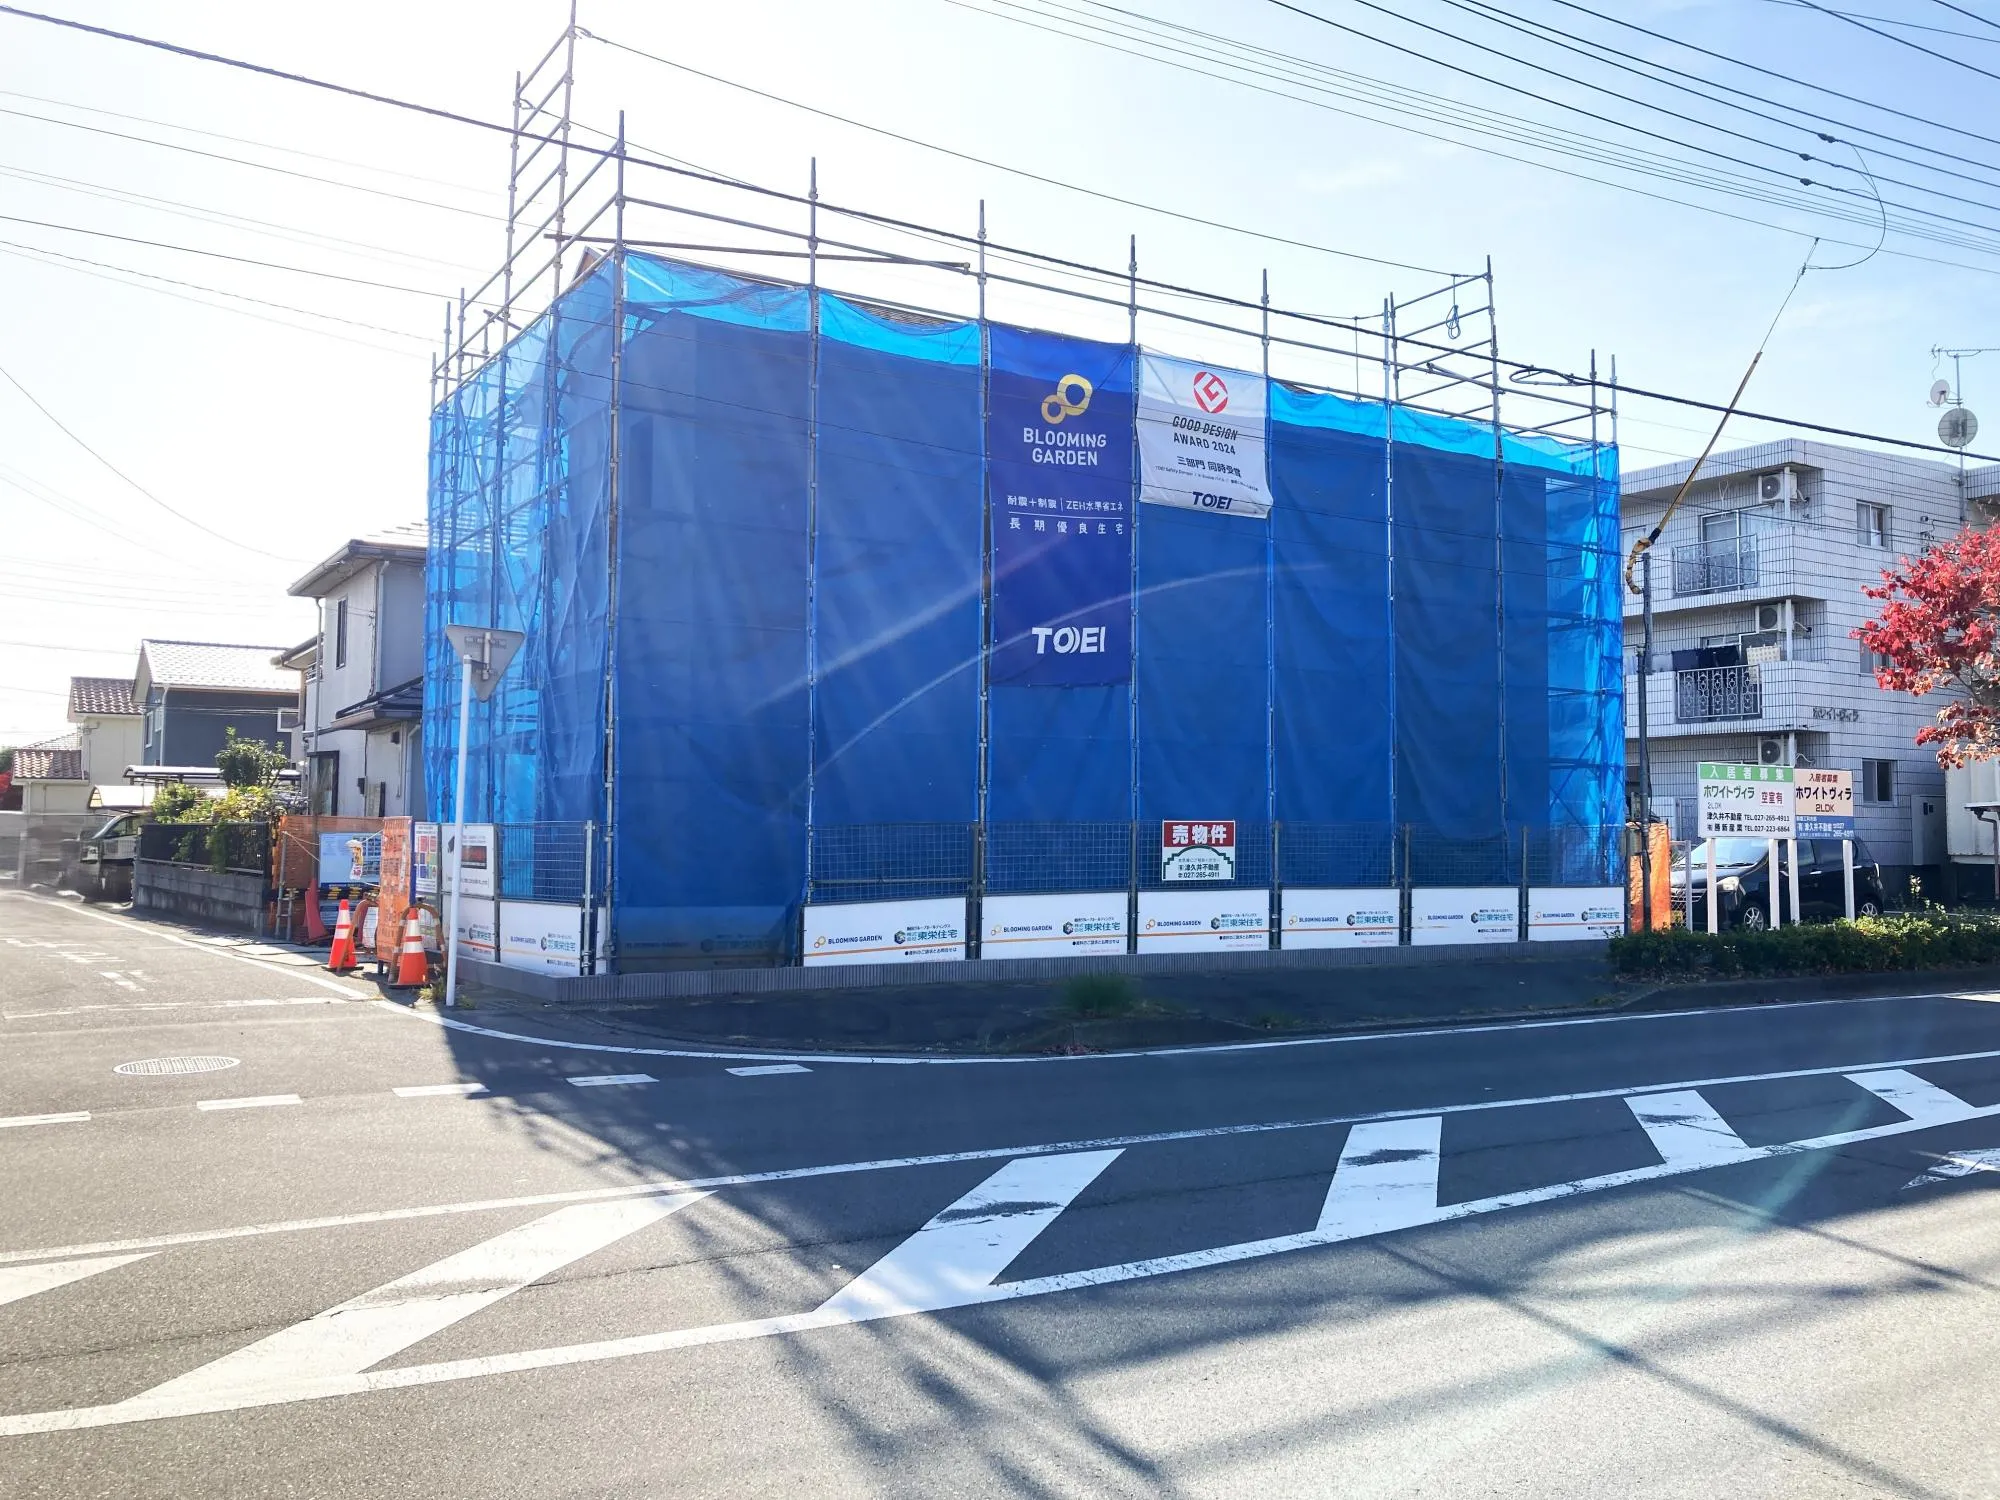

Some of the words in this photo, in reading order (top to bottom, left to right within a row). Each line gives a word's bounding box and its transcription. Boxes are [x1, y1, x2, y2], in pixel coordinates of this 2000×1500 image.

[1172, 416, 1201, 432] GOOD
[1203, 423, 1239, 440] DESIGN
[1023, 427, 1107, 448] BLOOMING
[1173, 432, 1210, 449] AWARD
[1211, 441, 1236, 455] 2024
[1032, 447, 1098, 466] GARDEN
[1177, 456, 1205, 470] 三部門
[1192, 491, 1233, 510] TOEI
[1009, 517, 1123, 535] 長期優良住宅
[1031, 626, 1106, 654] TOEI
[1710, 766, 1785, 781] 入居者募集
[1809, 773, 1838, 783] 入居者募集
[1703, 785, 1755, 799] ホワイトヴィラ
[1761, 791, 1783, 804] 空室有
[1795, 786, 1852, 800] ホワイトヴィラ
[1815, 803, 1835, 812] 2LDK
[1707, 812, 1742, 821] 津久井不動産
[1172, 824, 1227, 845] 売物件
[1084, 922, 1120, 931] 東栄住宅
[828, 936, 858, 945] BLOOMING
[918, 929, 957, 940] 東栄住宅
